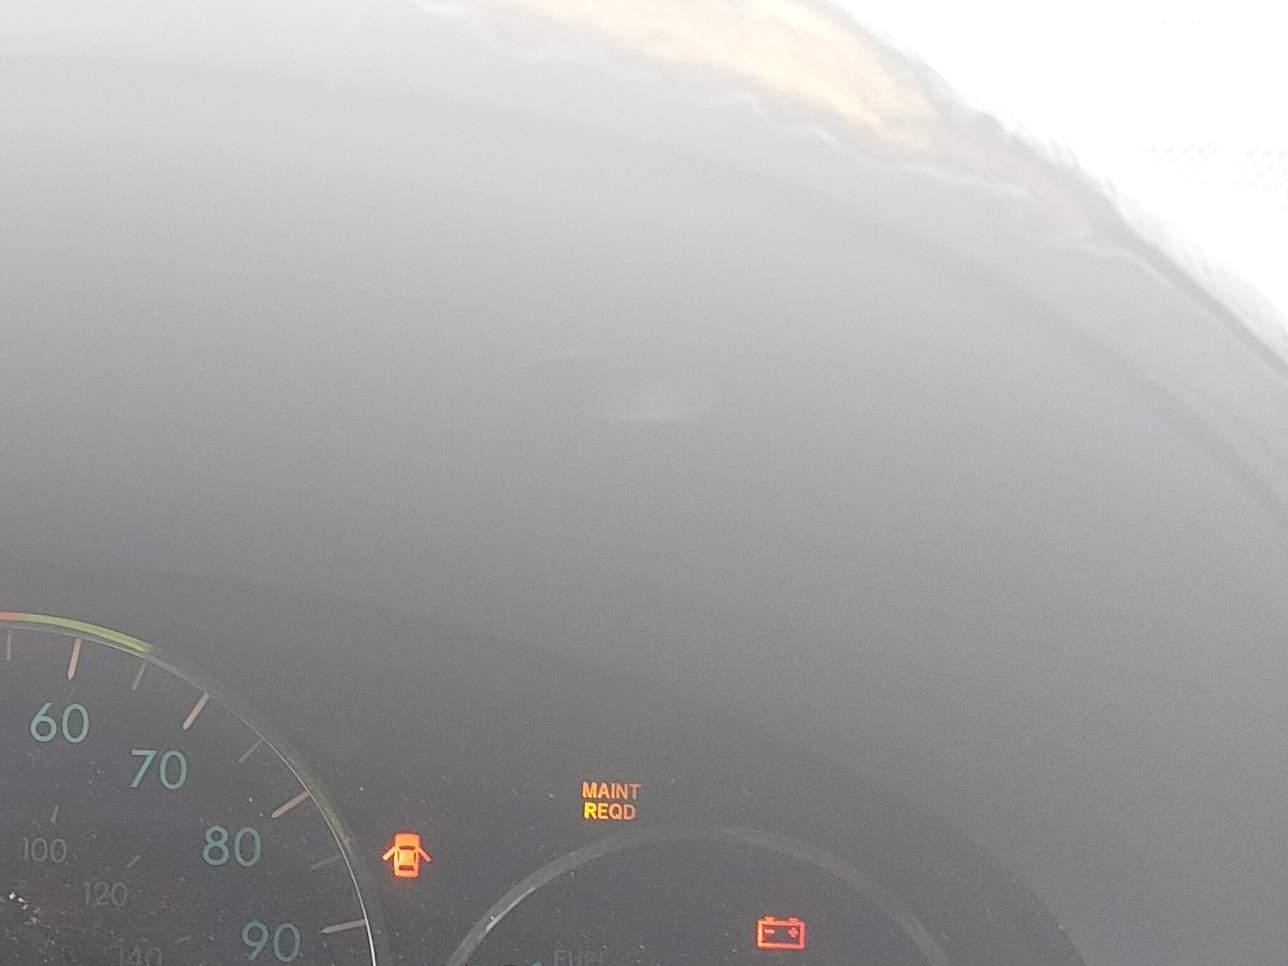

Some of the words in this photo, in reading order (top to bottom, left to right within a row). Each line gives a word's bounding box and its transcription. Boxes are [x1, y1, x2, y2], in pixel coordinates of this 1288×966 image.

[30, 702, 90, 744] 60
[130, 749, 189, 790] 70
[582, 781, 642, 800] MAINT
[584, 802, 636, 820] REQD
[22, 837, 67, 863] 100
[202, 825, 261, 867] 80
[83, 881, 128, 907] 120
[242, 920, 301, 963] 90
